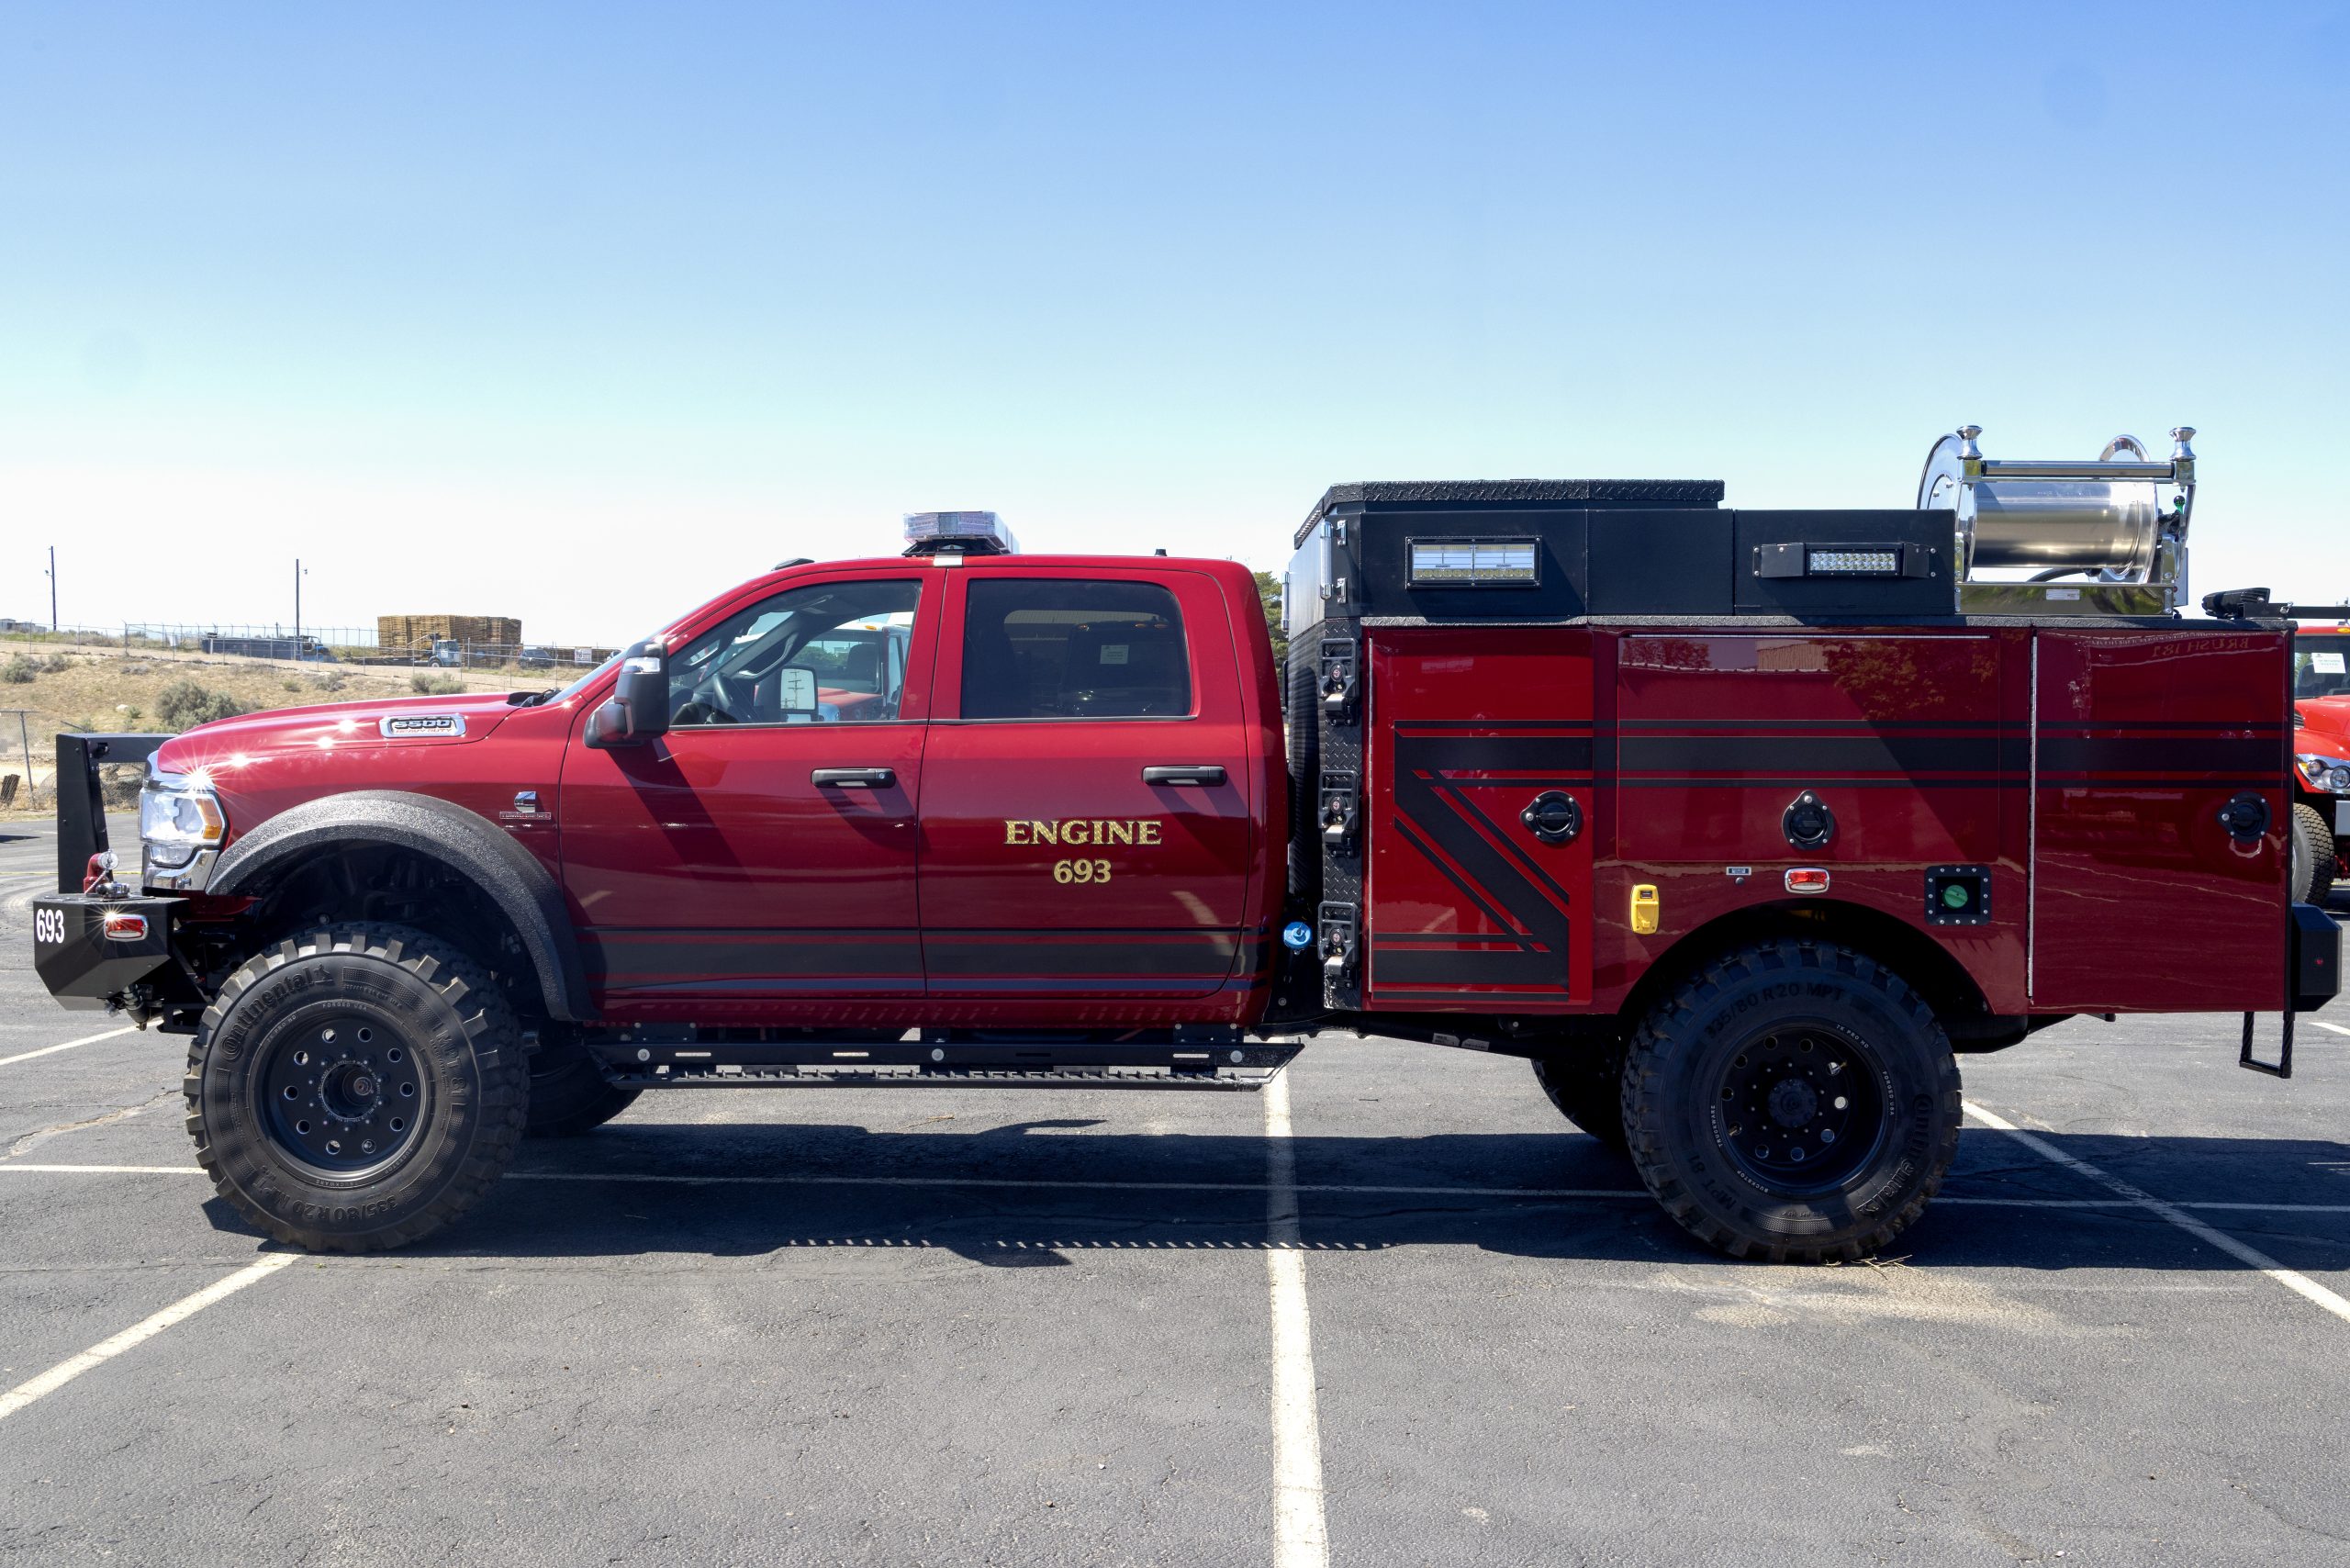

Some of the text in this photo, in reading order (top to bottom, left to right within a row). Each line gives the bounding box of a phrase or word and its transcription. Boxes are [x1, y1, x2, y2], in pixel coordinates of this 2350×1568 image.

[395, 719, 452, 730] 5500
[1003, 820, 1162, 845] ENGINE
[1053, 858, 1112, 884] 693
[37, 908, 65, 944] 693
